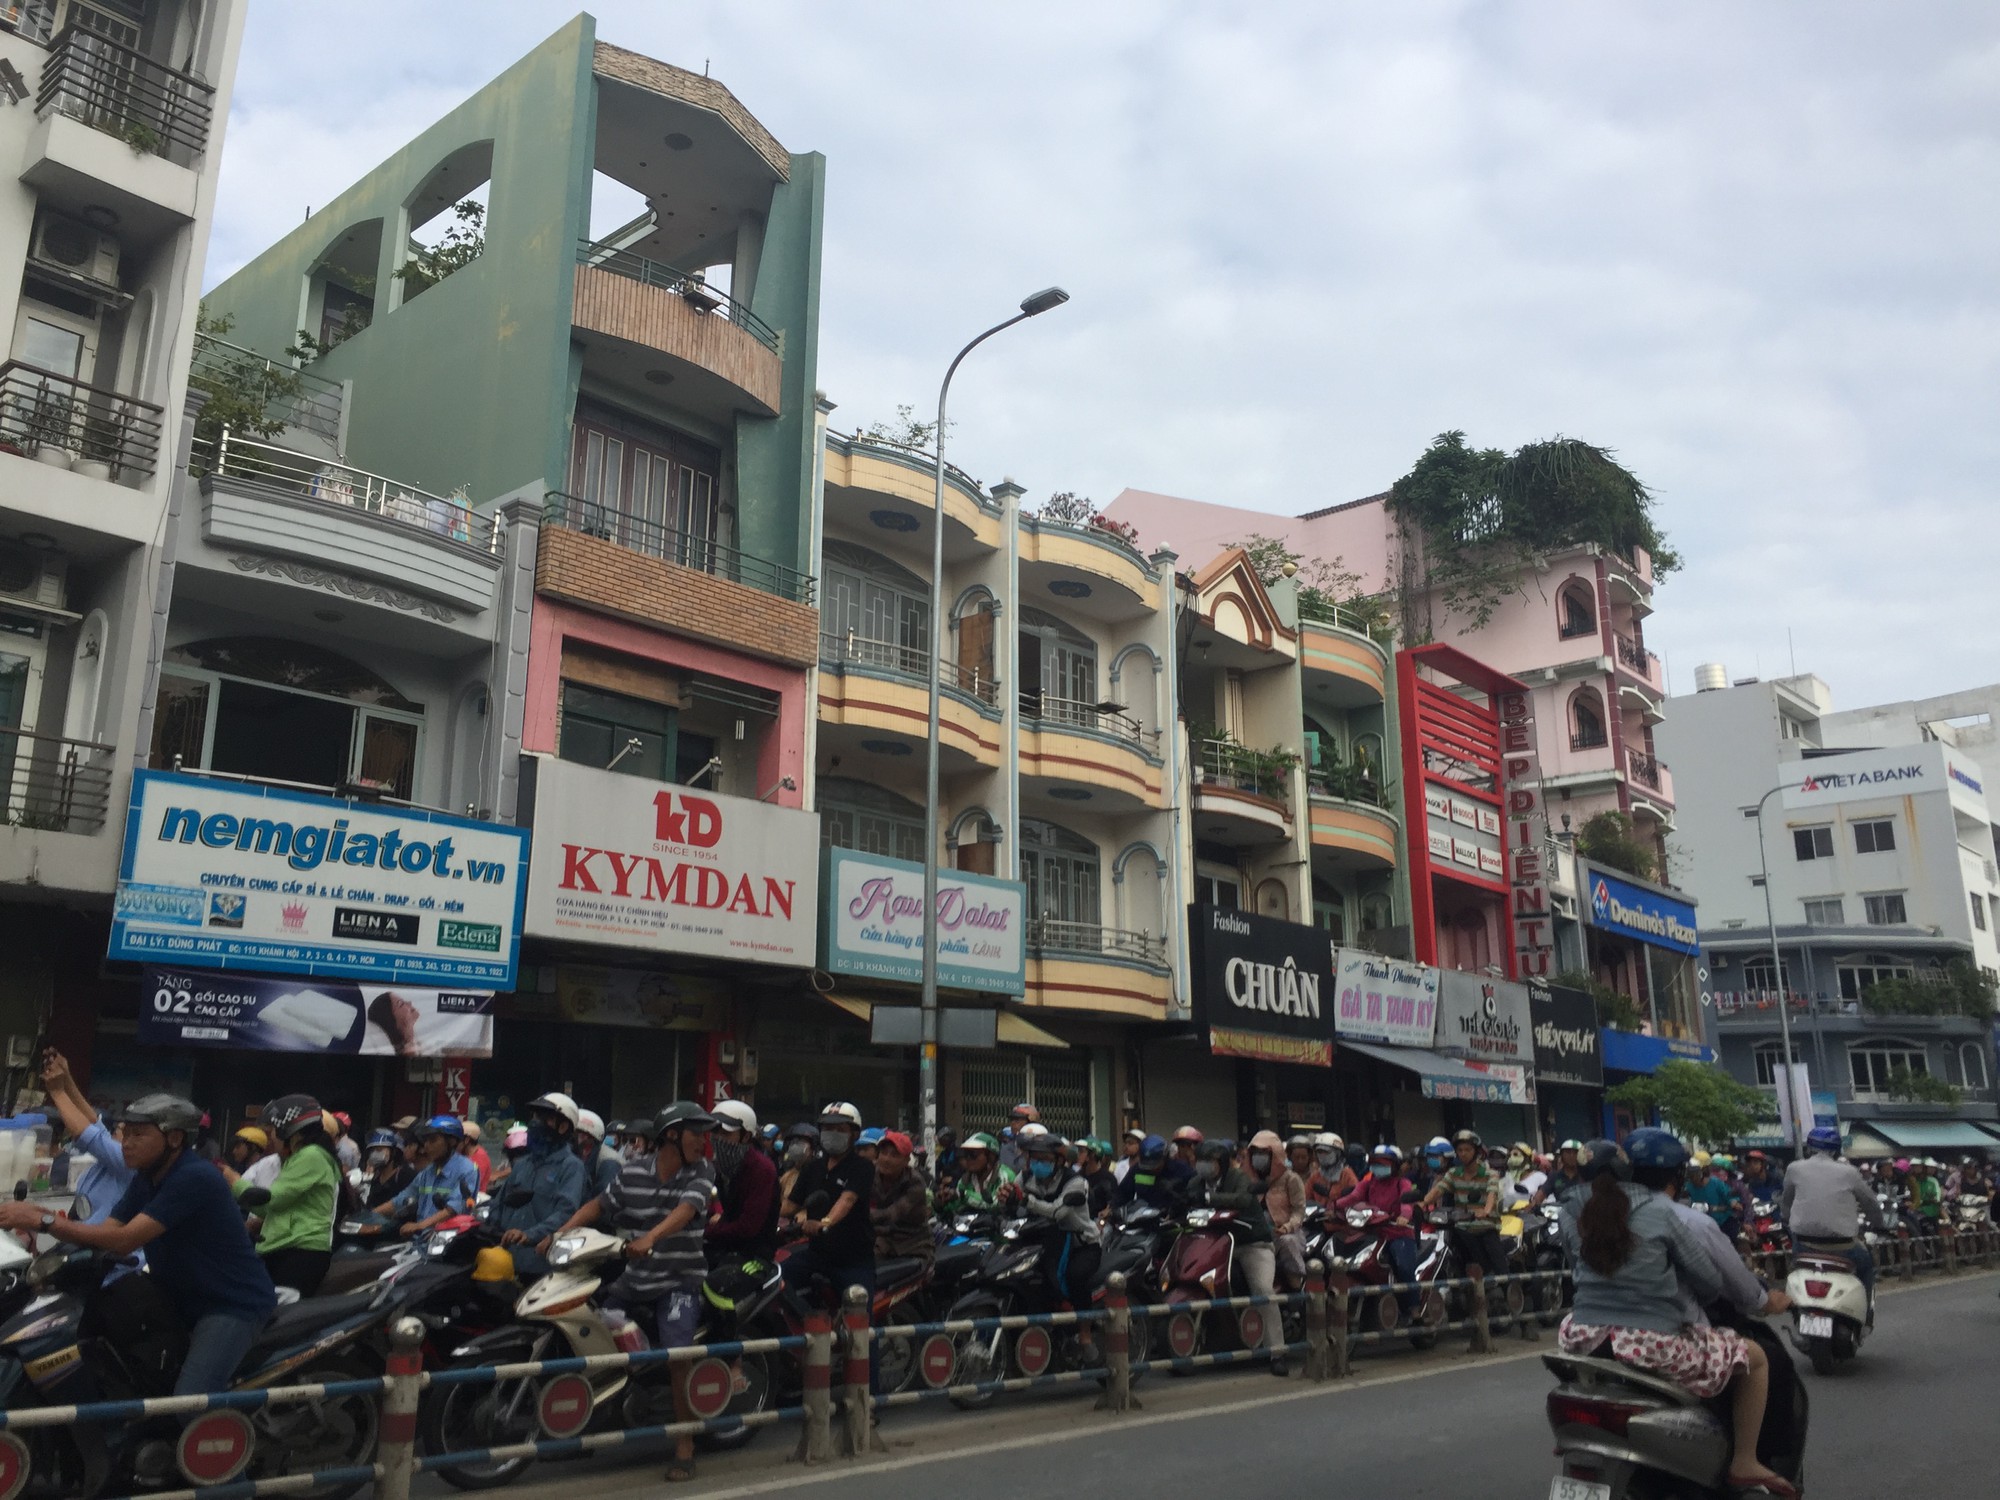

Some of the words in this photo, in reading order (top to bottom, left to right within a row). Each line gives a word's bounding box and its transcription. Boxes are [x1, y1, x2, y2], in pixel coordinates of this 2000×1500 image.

[1818, 765, 1923, 789] VIETABANK
[158, 807, 506, 885] nemgiatot.vn
[652, 842, 689, 857] SINCE
[693, 850, 718, 861] 1954
[200, 872, 245, 888] CHUYÊN
[249, 877, 278, 892] CUNG
[282, 879, 303, 895] CẤP
[320, 885, 327, 897] &
[384, 893, 409, 906] DRAP
[419, 894, 435, 909] GỐI
[558, 843, 796, 922] KYMDAN
[849, 877, 924, 925] Rau
[935, 886, 1011, 932] Dalat
[339, 911, 381, 928] LIEN
[1213, 910, 1250, 935] Fashion
[1610, 898, 1665, 937] Domino's
[1666, 915, 1696, 945] Pizza
[442, 921, 497, 945] Edena
[885, 928, 913, 949] hàng
[197, 938, 222, 951] PHÁT
[258, 945, 284, 957] KHÁNH
[360, 955, 375, 965] HCM
[730, 939, 794, 953] www.kymdan.com
[1363, 962, 1389, 980] Thanh
[1392, 967, 1421, 988] Phương
[153, 989, 191, 1014] 02
[194, 990, 215, 1002] GỐI
[217, 993, 240, 1005] CAO
[242, 995, 256, 1005] SU
[440, 996, 465, 1006] LIEN
[1531, 987, 1552, 1002] Fashion
[194, 1004, 217, 1016] CAO
[219, 1004, 241, 1017] CẤP
